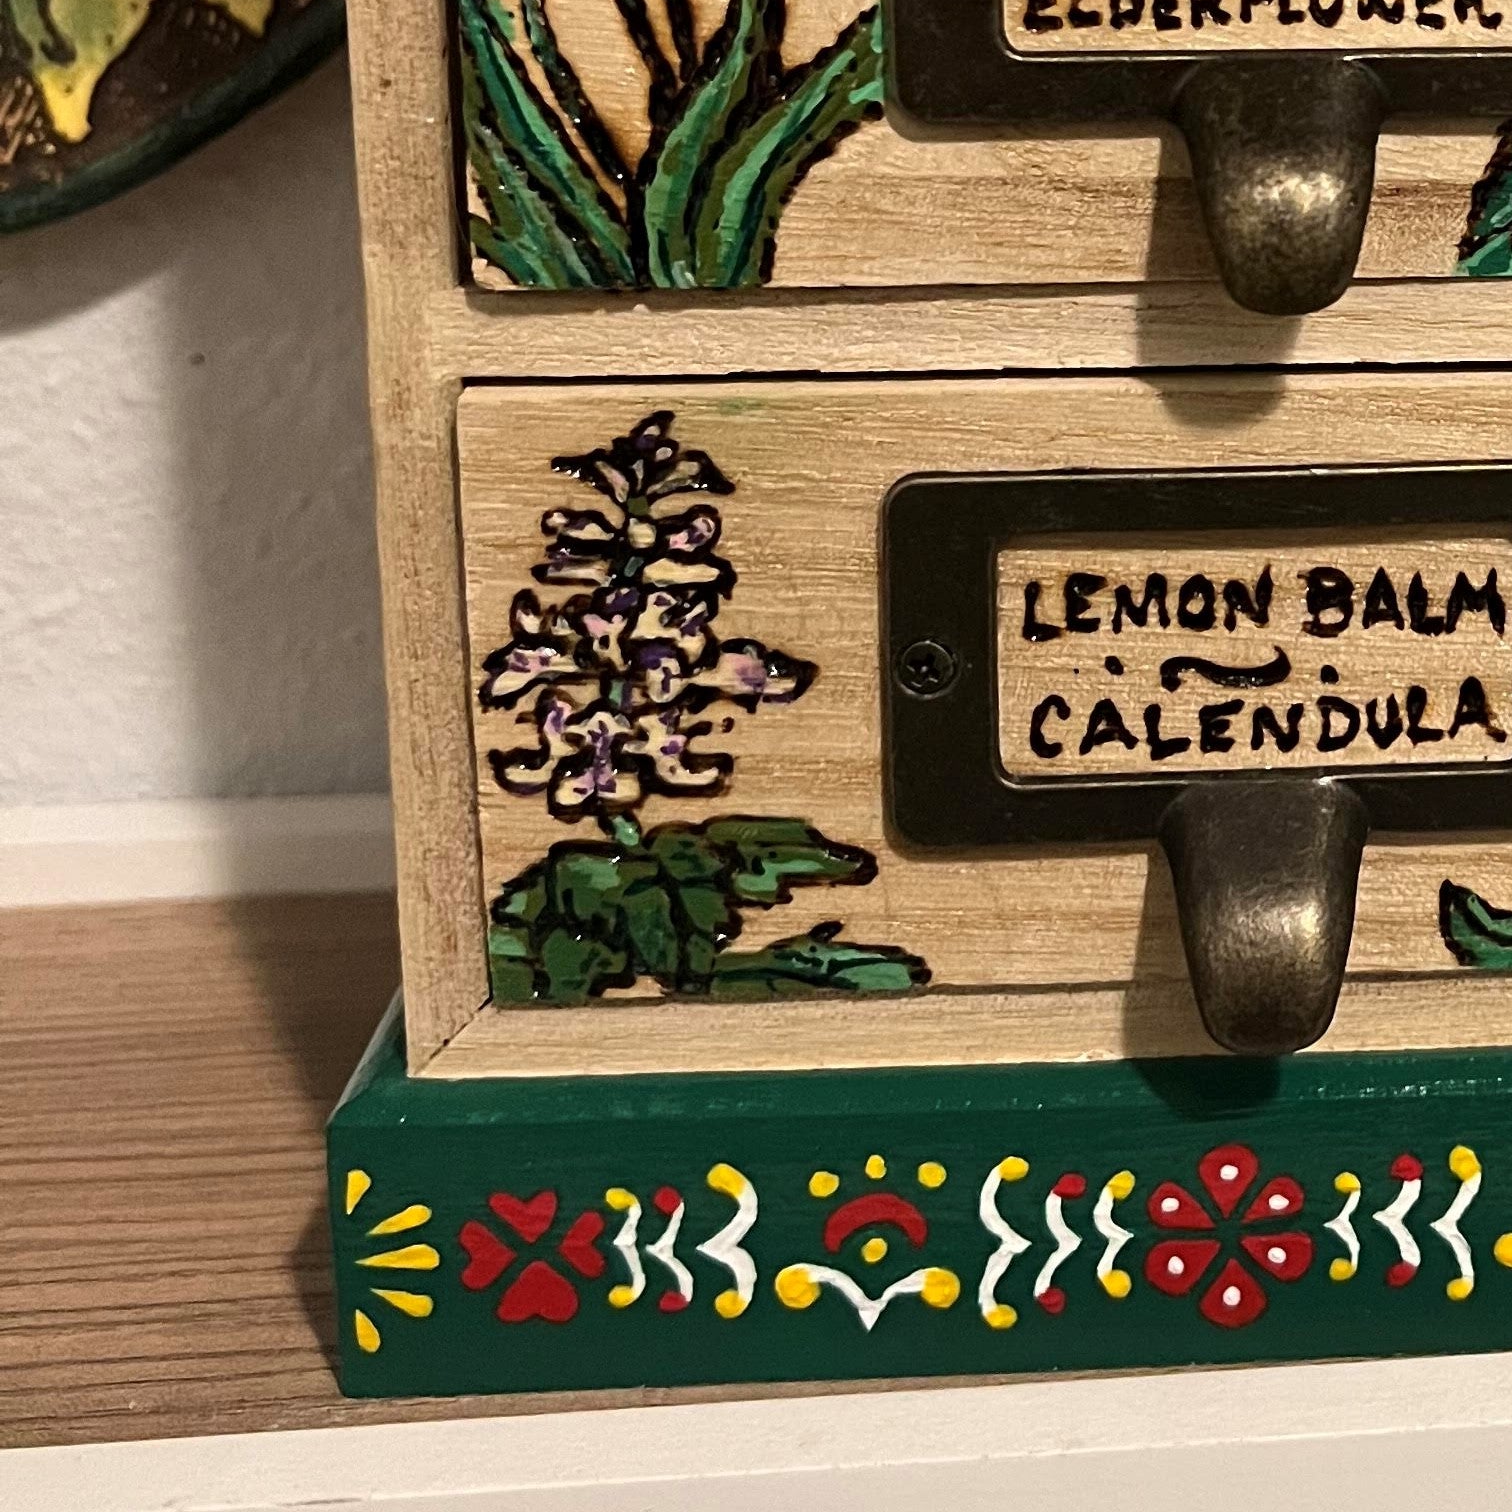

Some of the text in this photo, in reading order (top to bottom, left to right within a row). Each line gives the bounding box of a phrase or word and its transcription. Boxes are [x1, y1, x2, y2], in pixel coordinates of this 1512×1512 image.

[1023, 565, 1506, 641] LEMON BALM
[1030, 676, 1507, 760] CALENDULA
